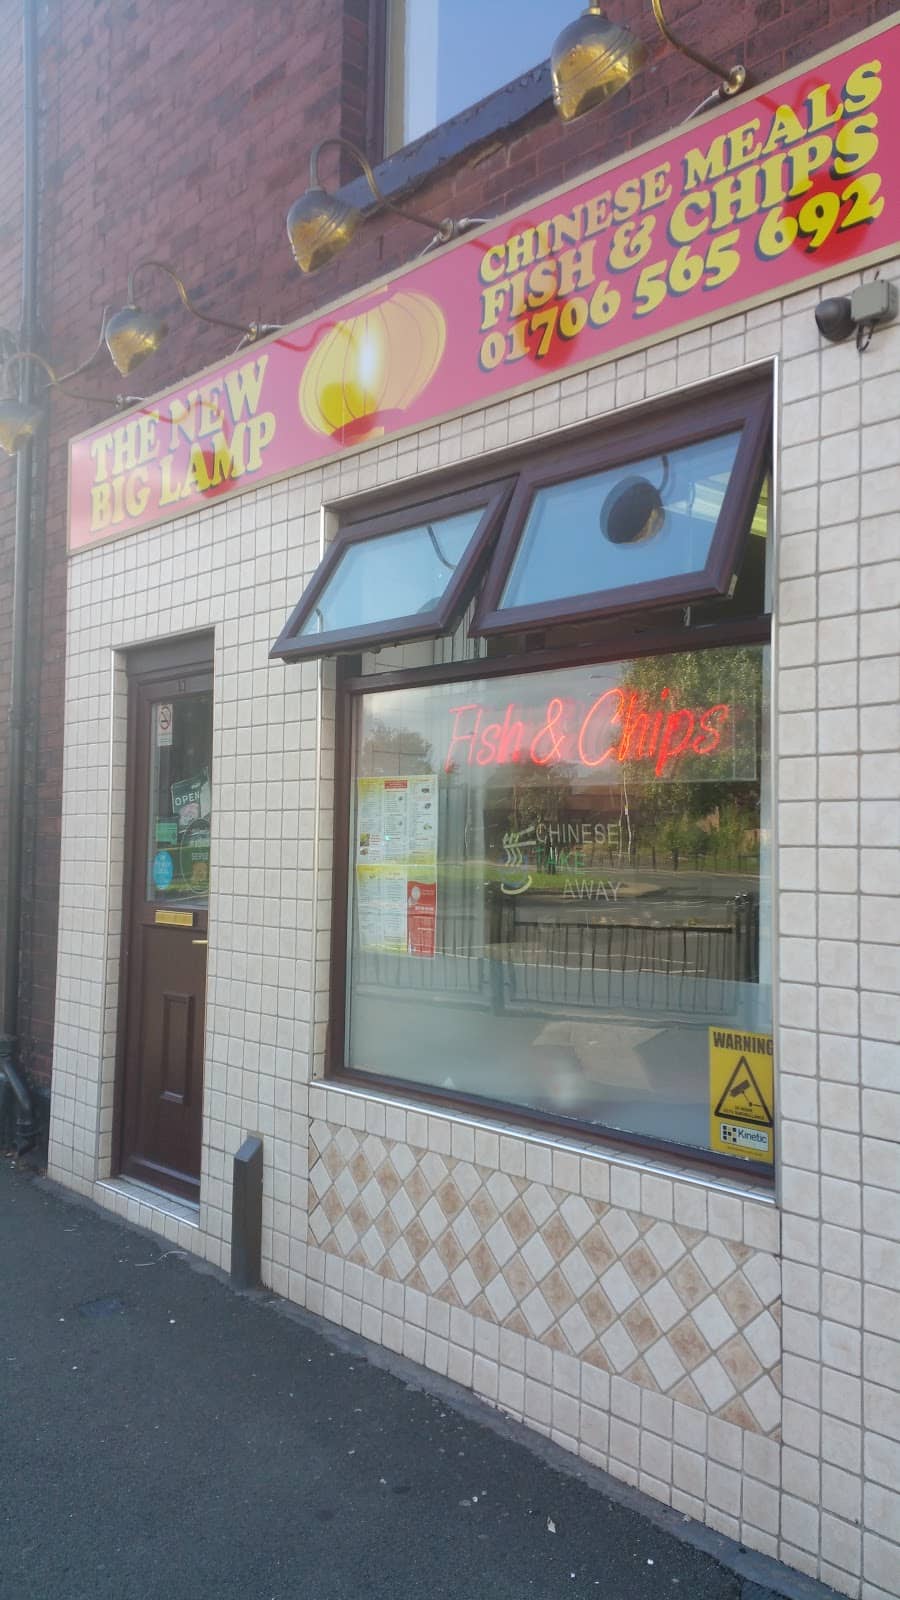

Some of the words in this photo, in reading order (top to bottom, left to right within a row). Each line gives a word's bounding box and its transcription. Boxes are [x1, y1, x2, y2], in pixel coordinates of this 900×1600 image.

[480, 161, 672, 282] CHINESE
[684, 60, 882, 190] MEALS
[481, 240, 595, 331] FISH
[607, 215, 656, 273] &
[667, 113, 879, 245] CHIPS
[479, 280, 621, 370] 01706
[633, 230, 741, 317] 565
[756, 172, 885, 260] 692
[91, 413, 159, 482] THE
[168, 355, 269, 450] NEW
[91, 467, 150, 532] BIG
[158, 411, 276, 507] LAMP
[444, 703, 525, 774] Fish
[530, 698, 565, 766] &
[579, 687, 729, 777] Chips
[175, 791, 200, 806] OPEN
[536, 823, 620, 844] CHINESE
[536, 847, 586, 867] TAKE
[563, 879, 621, 902] AWAY
[737, 1127, 768, 1144] Kinetic
